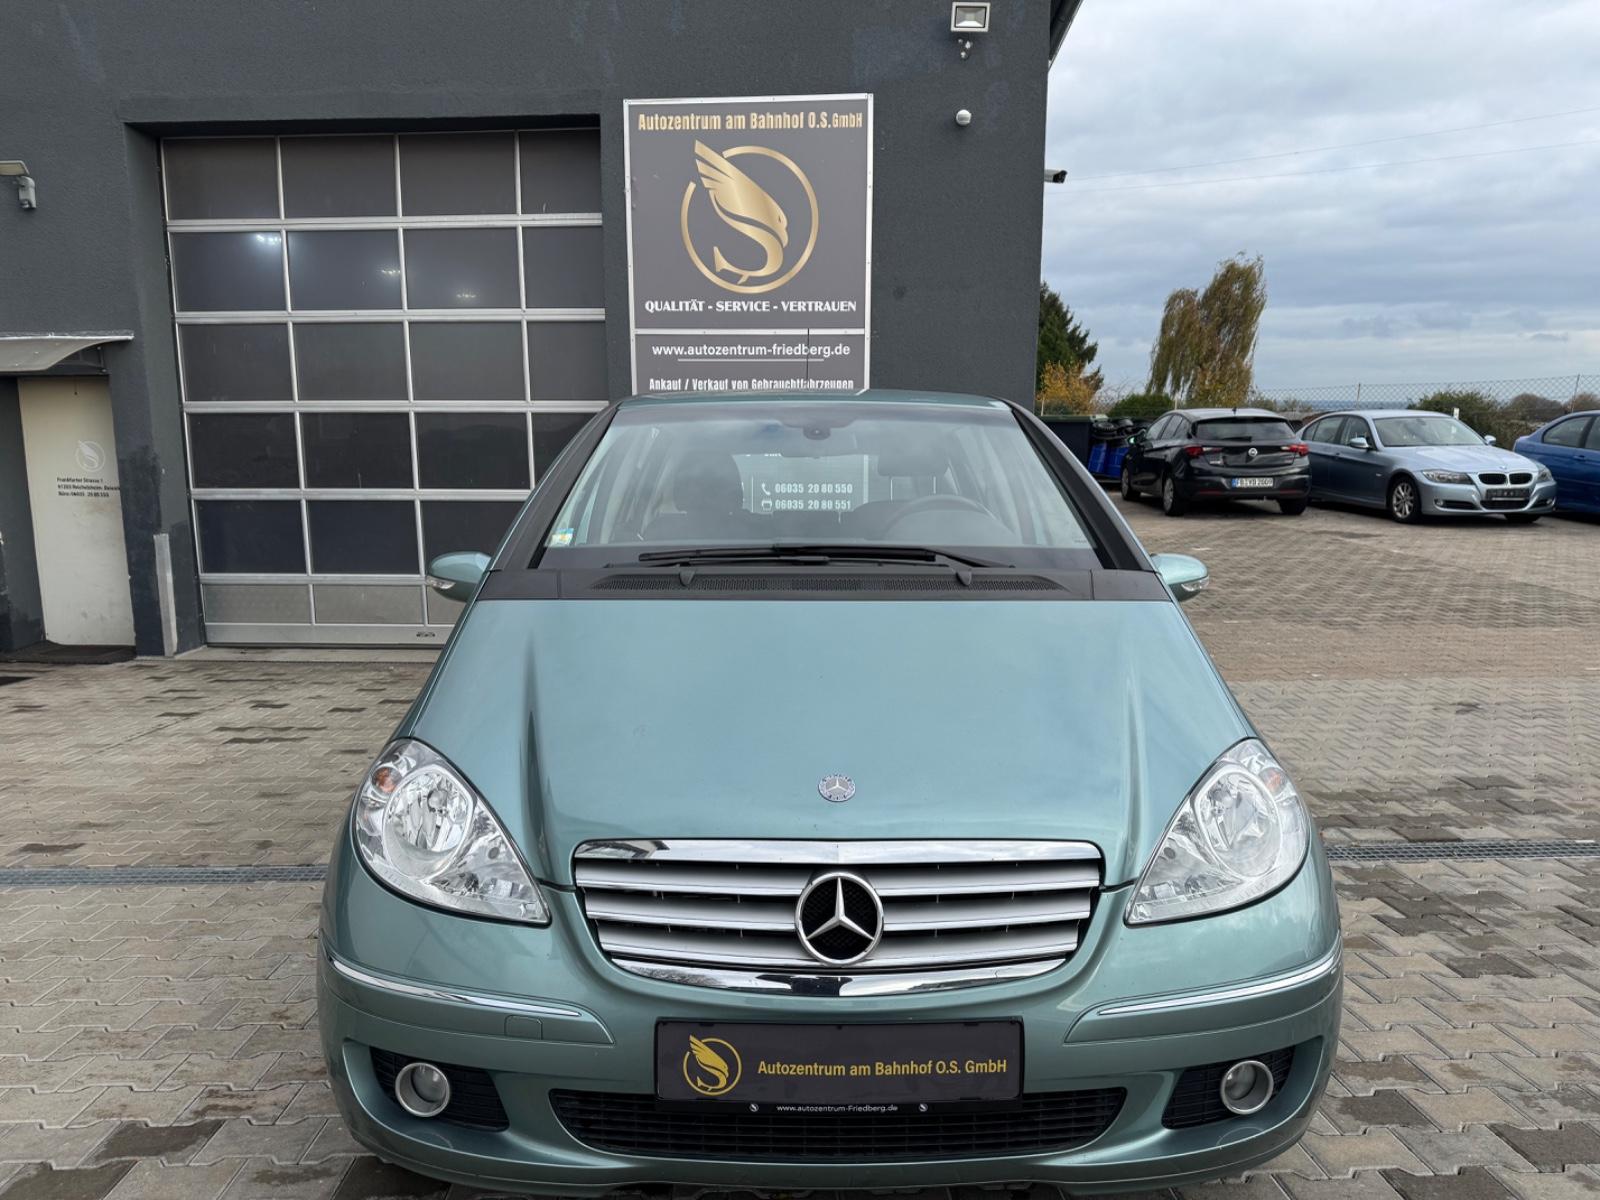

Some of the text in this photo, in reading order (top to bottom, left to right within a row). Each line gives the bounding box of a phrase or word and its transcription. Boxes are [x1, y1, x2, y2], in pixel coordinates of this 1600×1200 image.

[638, 113, 721, 131] Autozentrum
[725, 115, 746, 130] am
[750, 111, 804, 129] Bahnhof
[645, 299, 704, 312] QUALITÄT
[716, 300, 770, 312] SERVICE
[781, 300, 857, 312] VERTRAUEN
[652, 343, 850, 357] www.autozentrum-friedberg.de
[649, 378, 681, 391] Ankauf
[692, 378, 729, 391] Verkauf
[731, 379, 748, 390] von
[775, 483, 853, 493] 06035 20 80 550
[775, 499, 851, 510] 06035 20 80 551
[758, 1059, 1007, 1076] Autozentrum am Bahnhof O.S. GmbH
[776, 1104, 899, 1113] www.autozentrum-Friedberg.de
